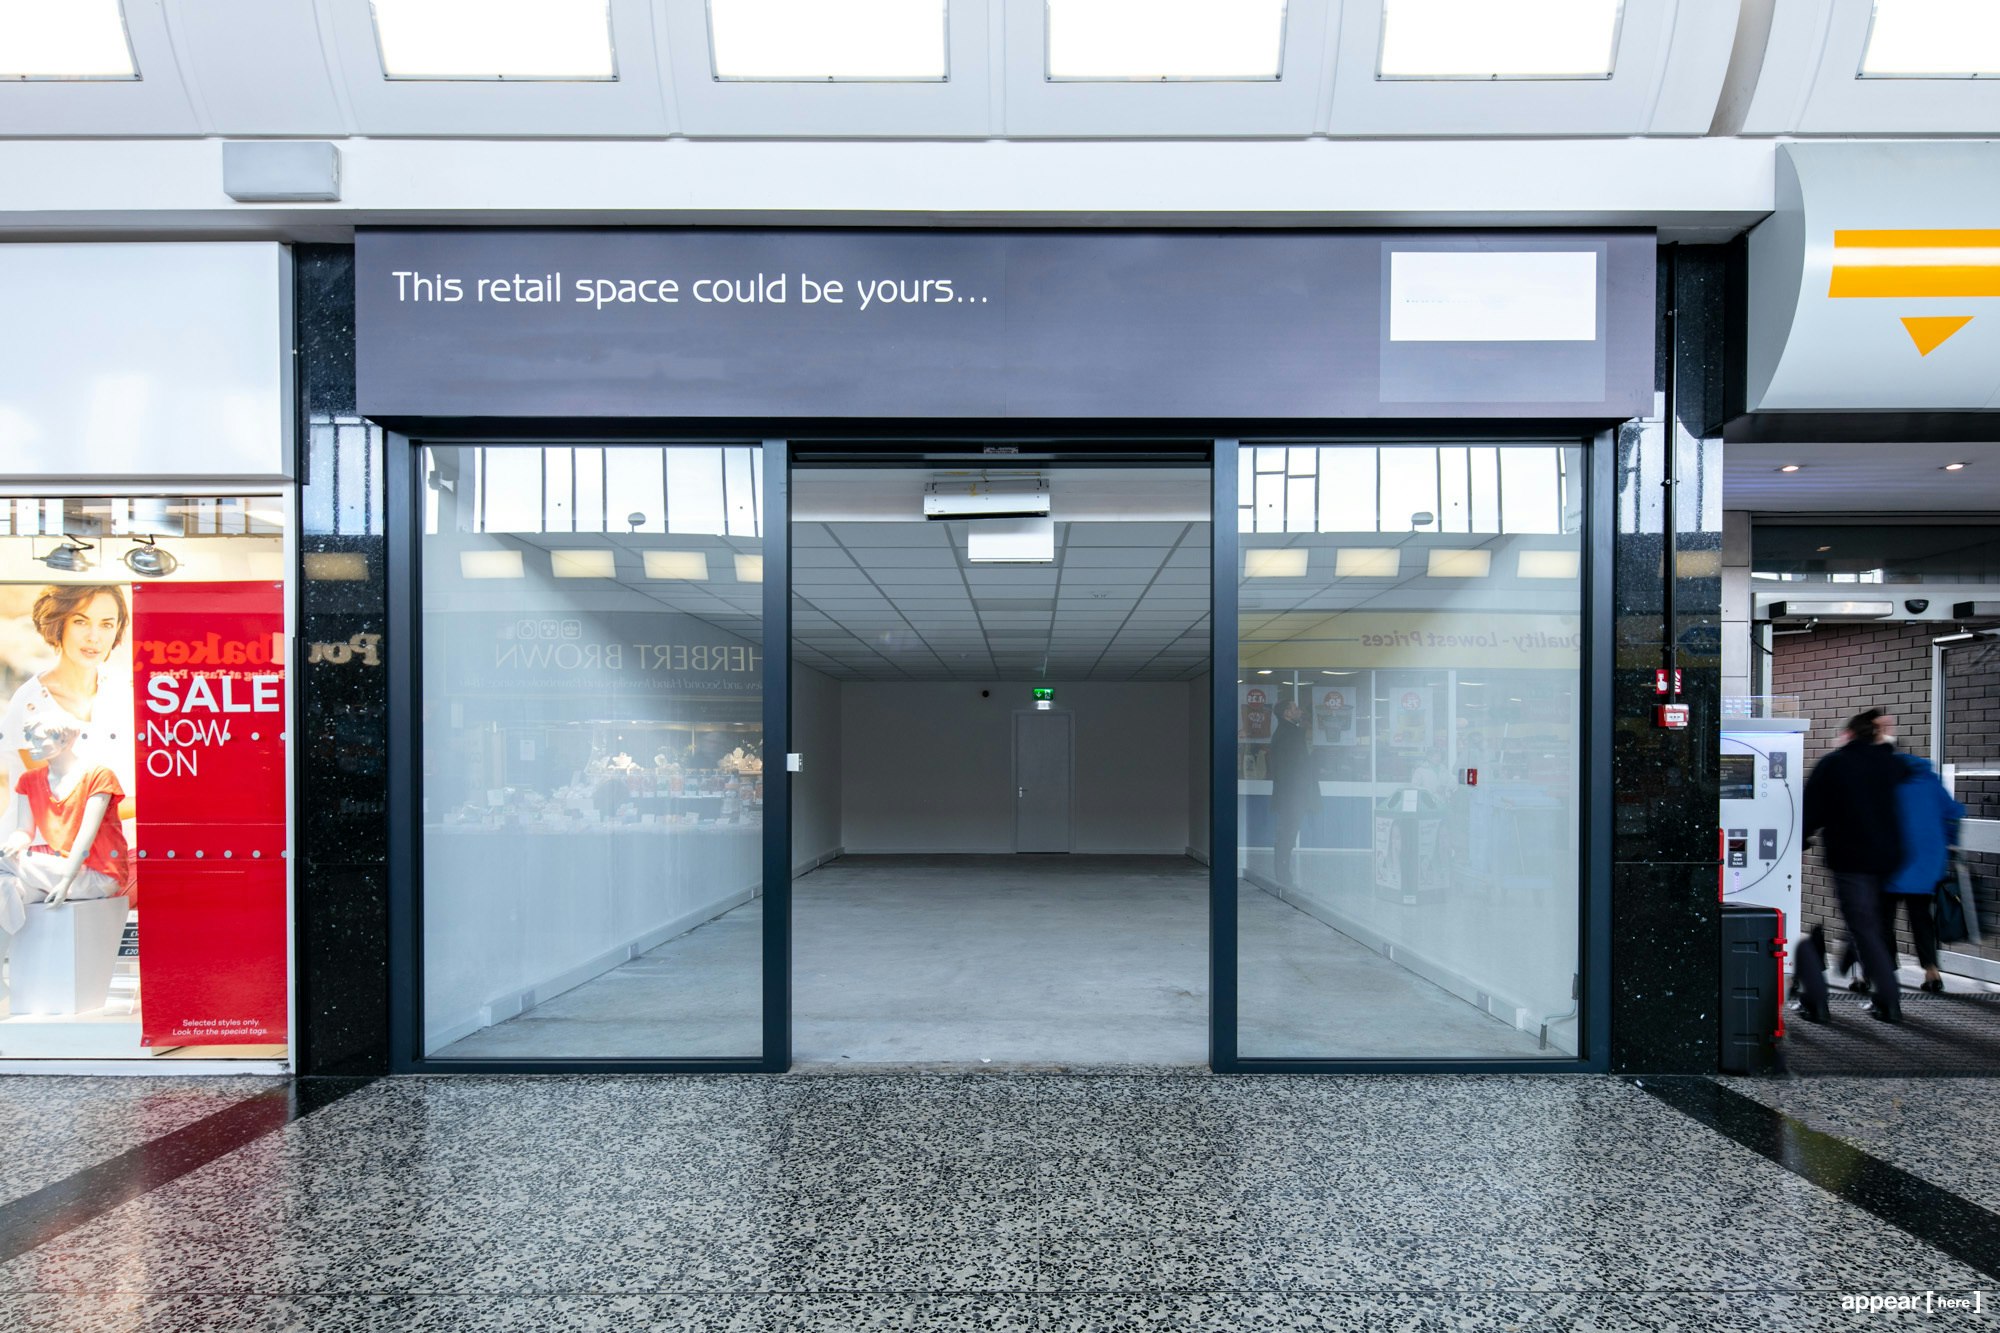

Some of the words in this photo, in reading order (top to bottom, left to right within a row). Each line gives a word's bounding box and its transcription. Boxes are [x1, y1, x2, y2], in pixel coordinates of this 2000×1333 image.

[391, 271, 464, 302] This
[478, 271, 561, 303] retail
[575, 279, 679, 310] space
[692, 272, 786, 303] could
[801, 273, 844, 304] be
[146, 675, 281, 713] SALE
[146, 718, 231, 748] NOW
[146, 749, 198, 778] ON
[172, 1028, 192, 1036] Look
[193, 1027, 204, 1036] for
[205, 1027, 219, 1036] the
[220, 1027, 249, 1037] special
[182, 1019, 217, 1027] Selected
[218, 1019, 241, 1028] styles
